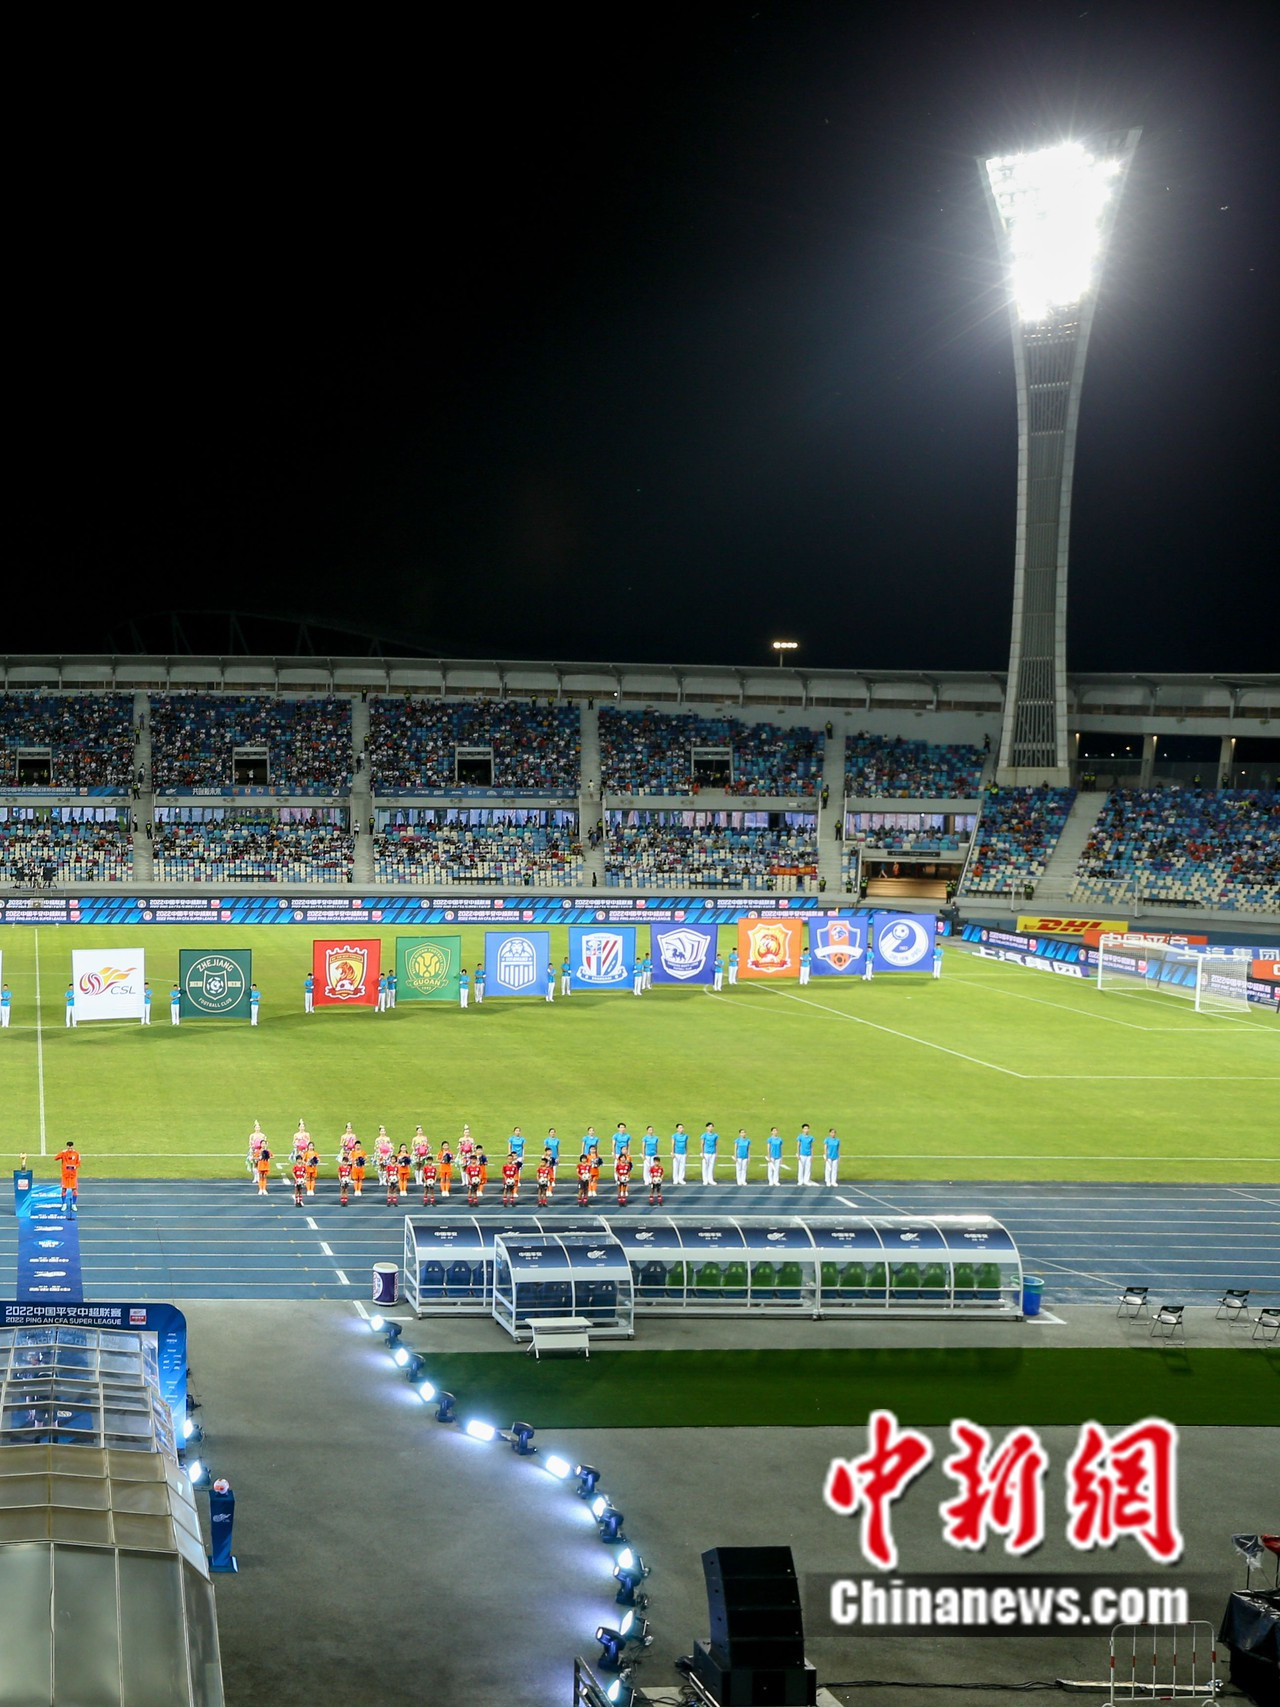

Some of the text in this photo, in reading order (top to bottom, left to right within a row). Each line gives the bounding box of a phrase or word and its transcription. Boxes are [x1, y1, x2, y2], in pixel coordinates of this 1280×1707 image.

[1037, 919, 1102, 932] DHL
[196, 958, 234, 972] ZHEJIANG
[972, 946, 1082, 977] 上汽集团
[413, 979, 441, 987] GUOAN
[110, 985, 136, 995] CSL
[5, 1306, 122, 1316] 2022中国平安中超联赛
[69, 1317, 93, 1325] SUPER
[94, 1317, 122, 1325] LEAGUE
